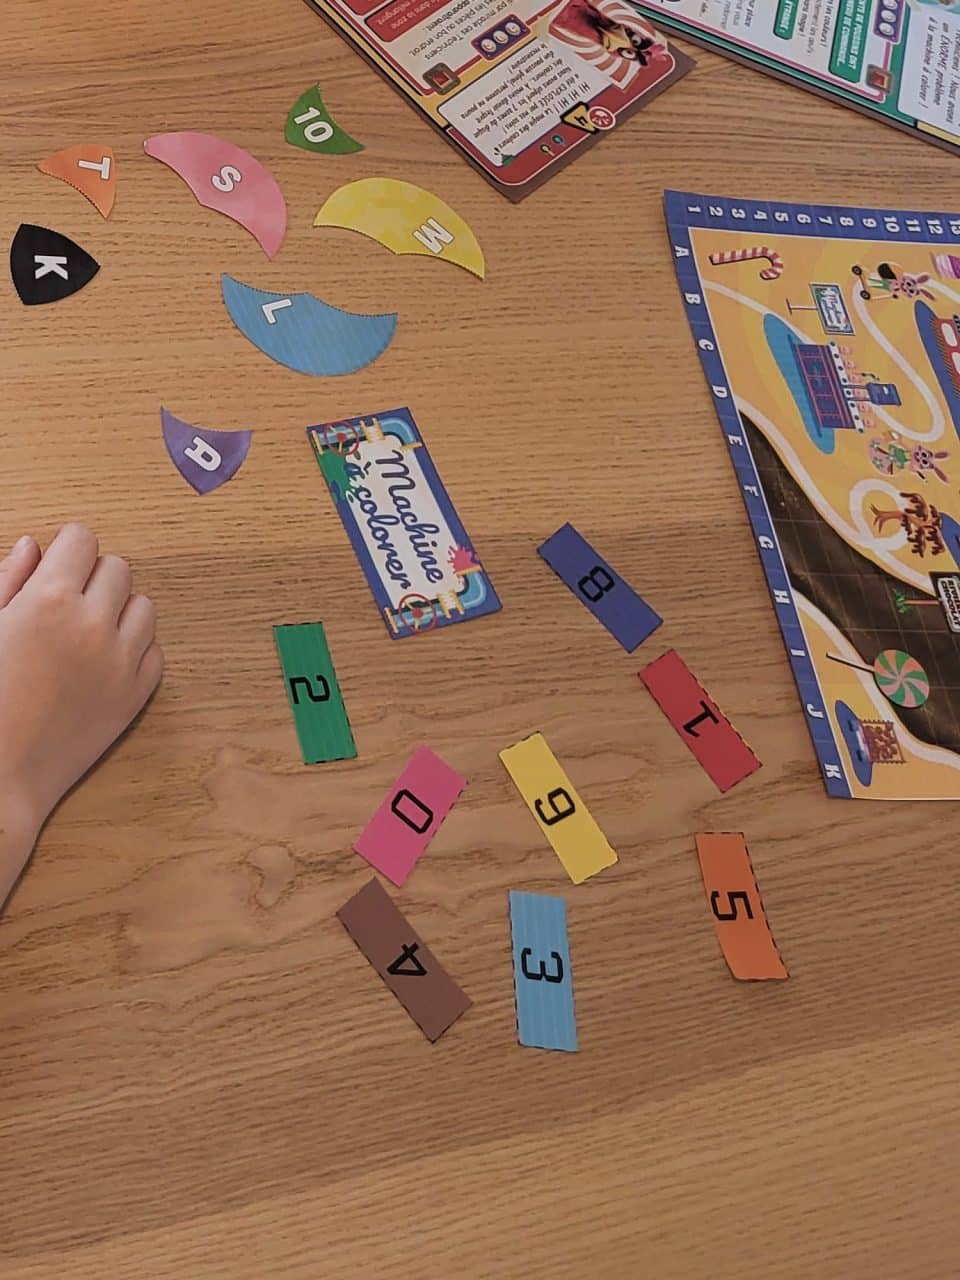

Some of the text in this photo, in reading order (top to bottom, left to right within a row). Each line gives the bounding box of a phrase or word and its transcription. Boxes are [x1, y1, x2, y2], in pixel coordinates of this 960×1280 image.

[927, 23, 937, 33] la
[922, 32, 936, 67] machine
[555, 95, 571, 109] HI
[565, 88, 582, 102] HI
[576, 80, 592, 94] HI
[918, 73, 931, 103] colorer
[929, 68, 946, 107] problème
[294, 106, 335, 144] 10
[496, 130, 522, 151] couleurs
[78, 154, 112, 181] T
[211, 165, 242, 193] S
[687, 206, 701, 214] 1
[709, 206, 724, 218] 2
[731, 207, 746, 220] 3
[753, 210, 768, 221] 4
[774, 211, 790, 223] 5
[796, 213, 812, 225] 6
[818, 216, 834, 225] 7
[839, 216, 854, 227] 8
[862, 218, 877, 229] 9
[883, 217, 900, 233] 10
[905, 219, 921, 233] 11
[926, 220, 944, 235] 12
[33, 253, 69, 282] K
[261, 298, 293, 325] L
[183, 436, 223, 472] A
[375, 449, 444, 583] Machine
[674, 245, 842, 780] A B C D E F G H I J K
[353, 486, 412, 590] colorer
[577, 565, 616, 604] 8
[289, 674, 331, 705] 2
[682, 700, 720, 738] 1
[534, 786, 576, 827] 9
[710, 889, 753, 922] 5
[386, 943, 427, 978] 4
[520, 946, 564, 984] 3
